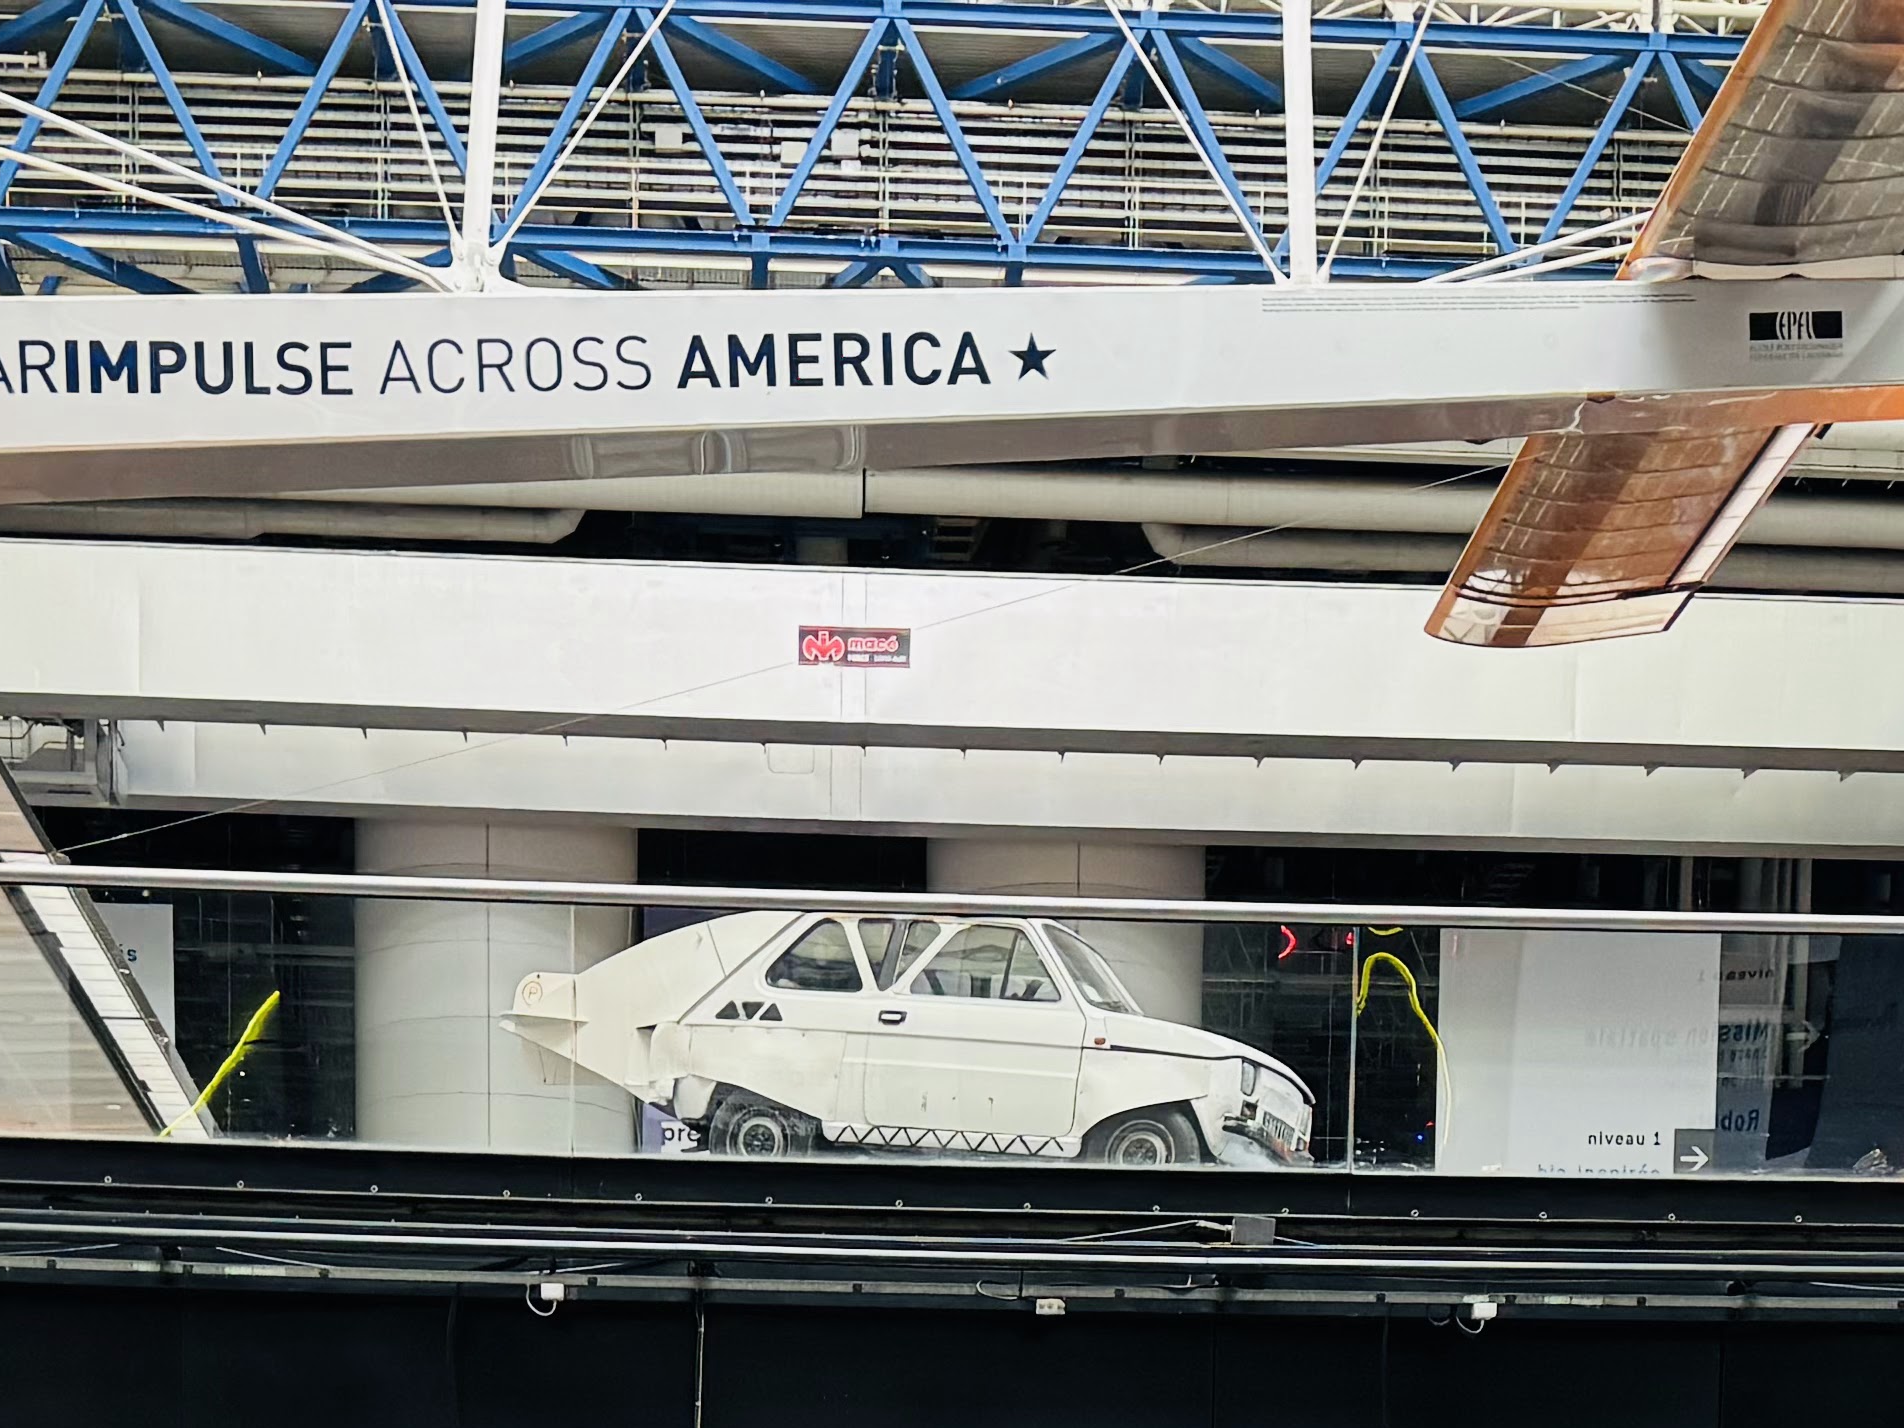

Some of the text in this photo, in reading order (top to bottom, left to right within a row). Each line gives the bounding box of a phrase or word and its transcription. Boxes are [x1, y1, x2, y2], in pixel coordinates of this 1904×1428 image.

[379, 334, 652, 395] ACROSS
[676, 330, 991, 390] AMERICA
[1587, 1131, 1662, 1146] niveau 1
